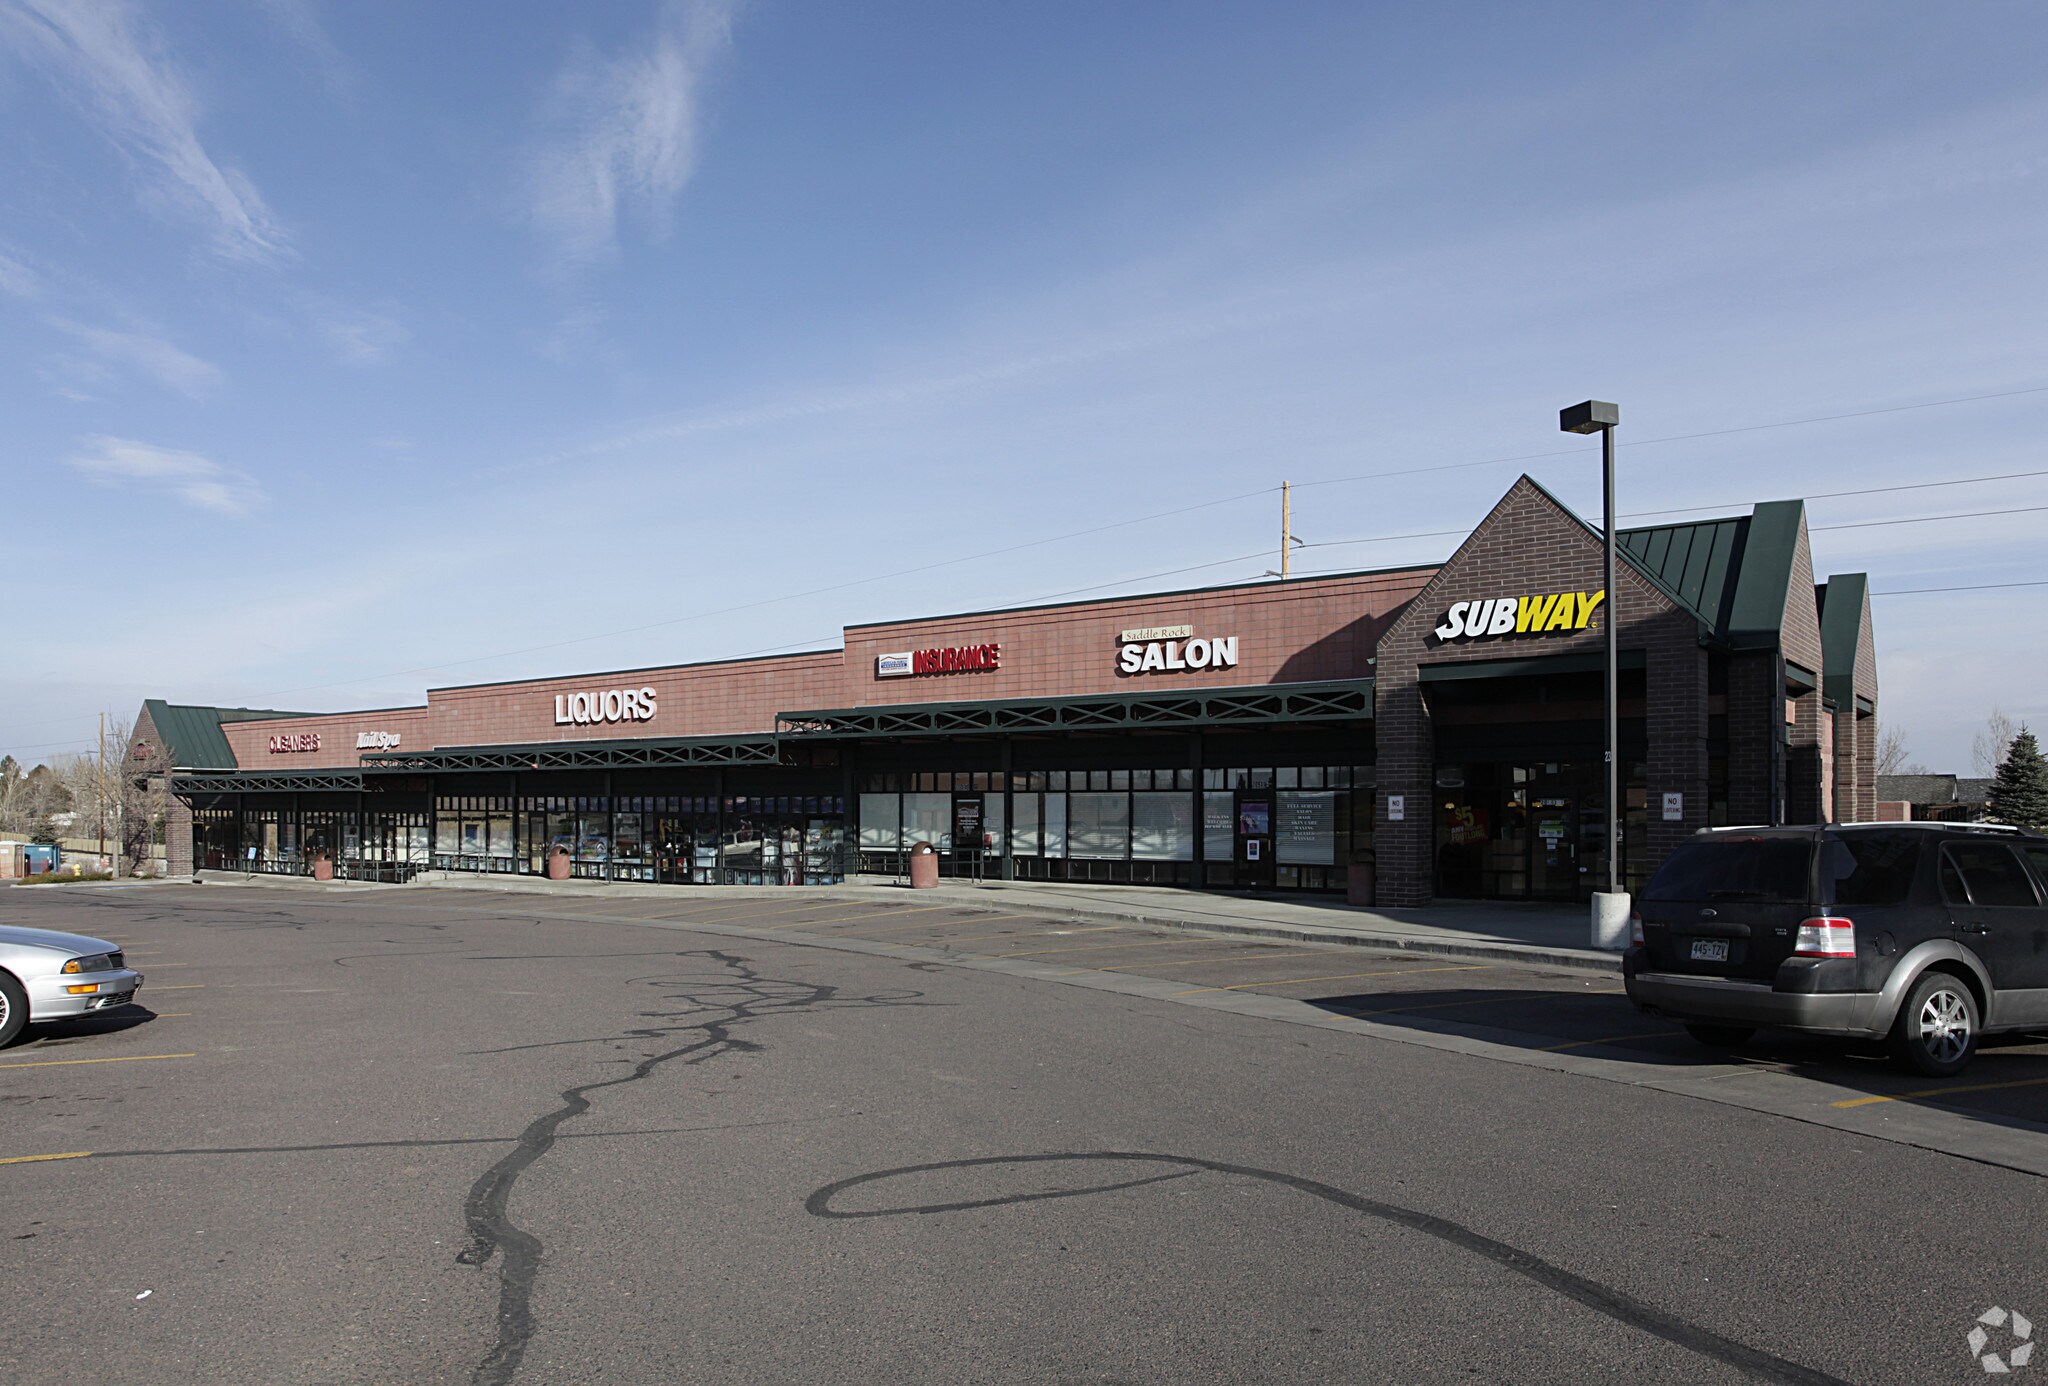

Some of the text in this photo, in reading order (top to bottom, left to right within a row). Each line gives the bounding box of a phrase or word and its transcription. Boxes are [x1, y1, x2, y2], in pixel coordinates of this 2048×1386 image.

[1435, 589, 1605, 641] SUBWAY
[1125, 626, 1187, 640] Saddle Rock
[914, 644, 1001, 673] INSURANCE
[1120, 637, 1238, 673] SALON
[555, 687, 657, 723] LIQUORS
[269, 733, 321, 753] CLEANERS
[356, 731, 401, 751] Nail Spa
[1667, 797, 1678, 805] NO
